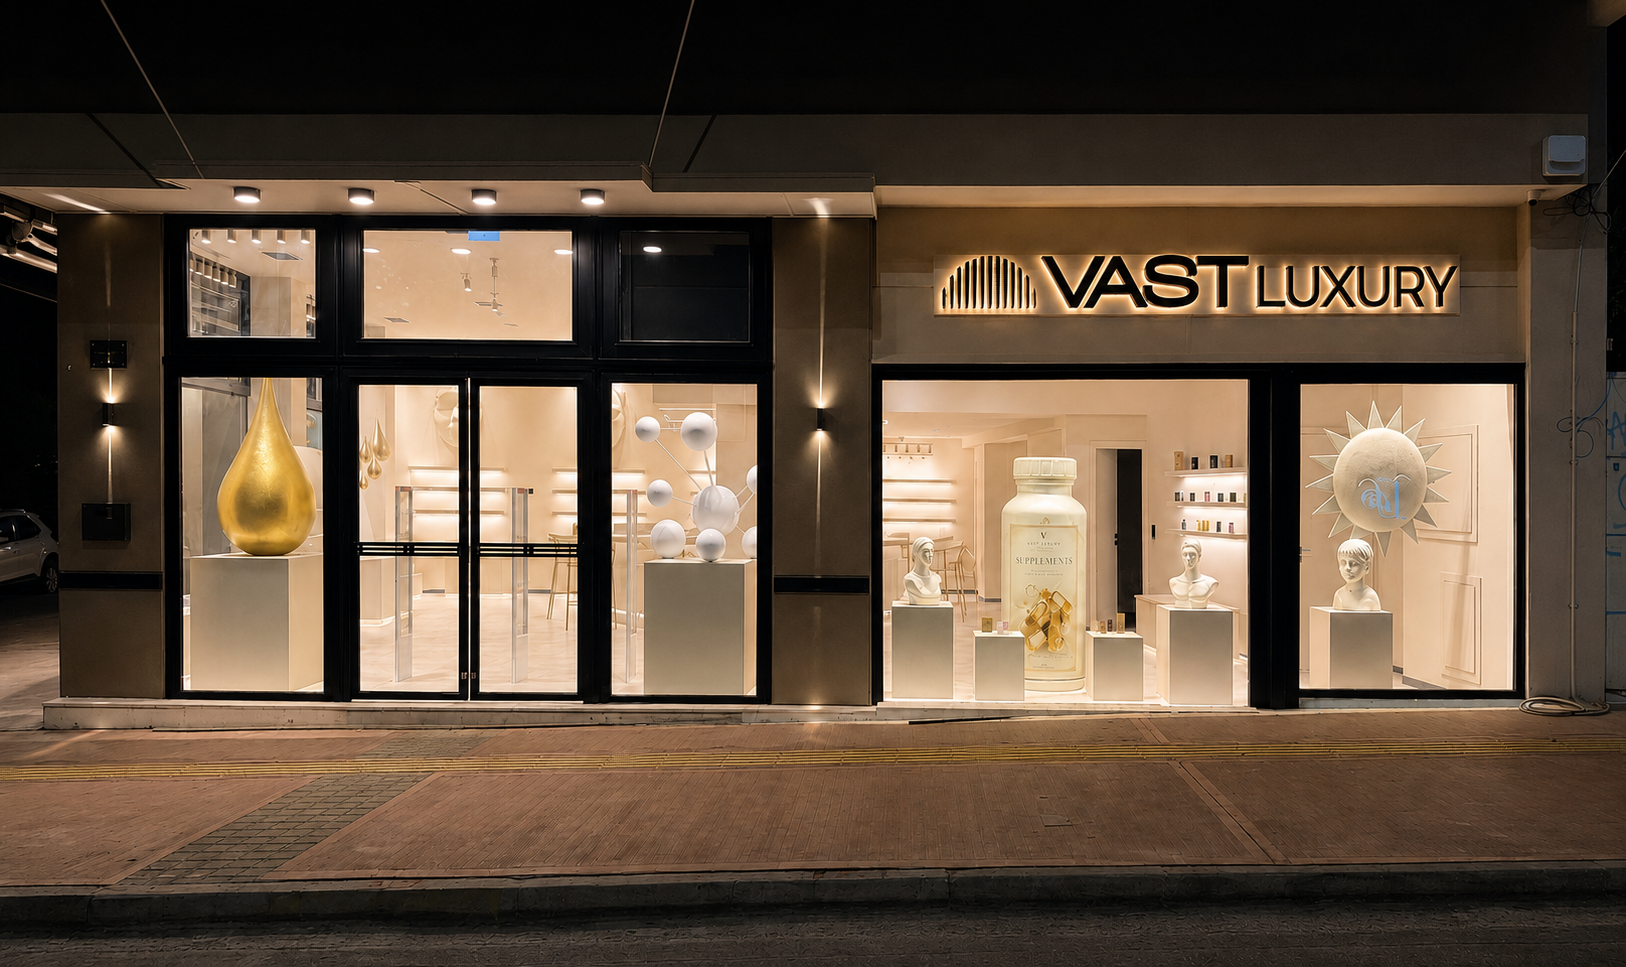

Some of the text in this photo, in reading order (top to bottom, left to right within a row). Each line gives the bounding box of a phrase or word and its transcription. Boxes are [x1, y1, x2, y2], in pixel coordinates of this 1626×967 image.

[1041, 254, 1459, 309] VAST LUXURY
[1015, 556, 1073, 565] SUPPLEMENTS
